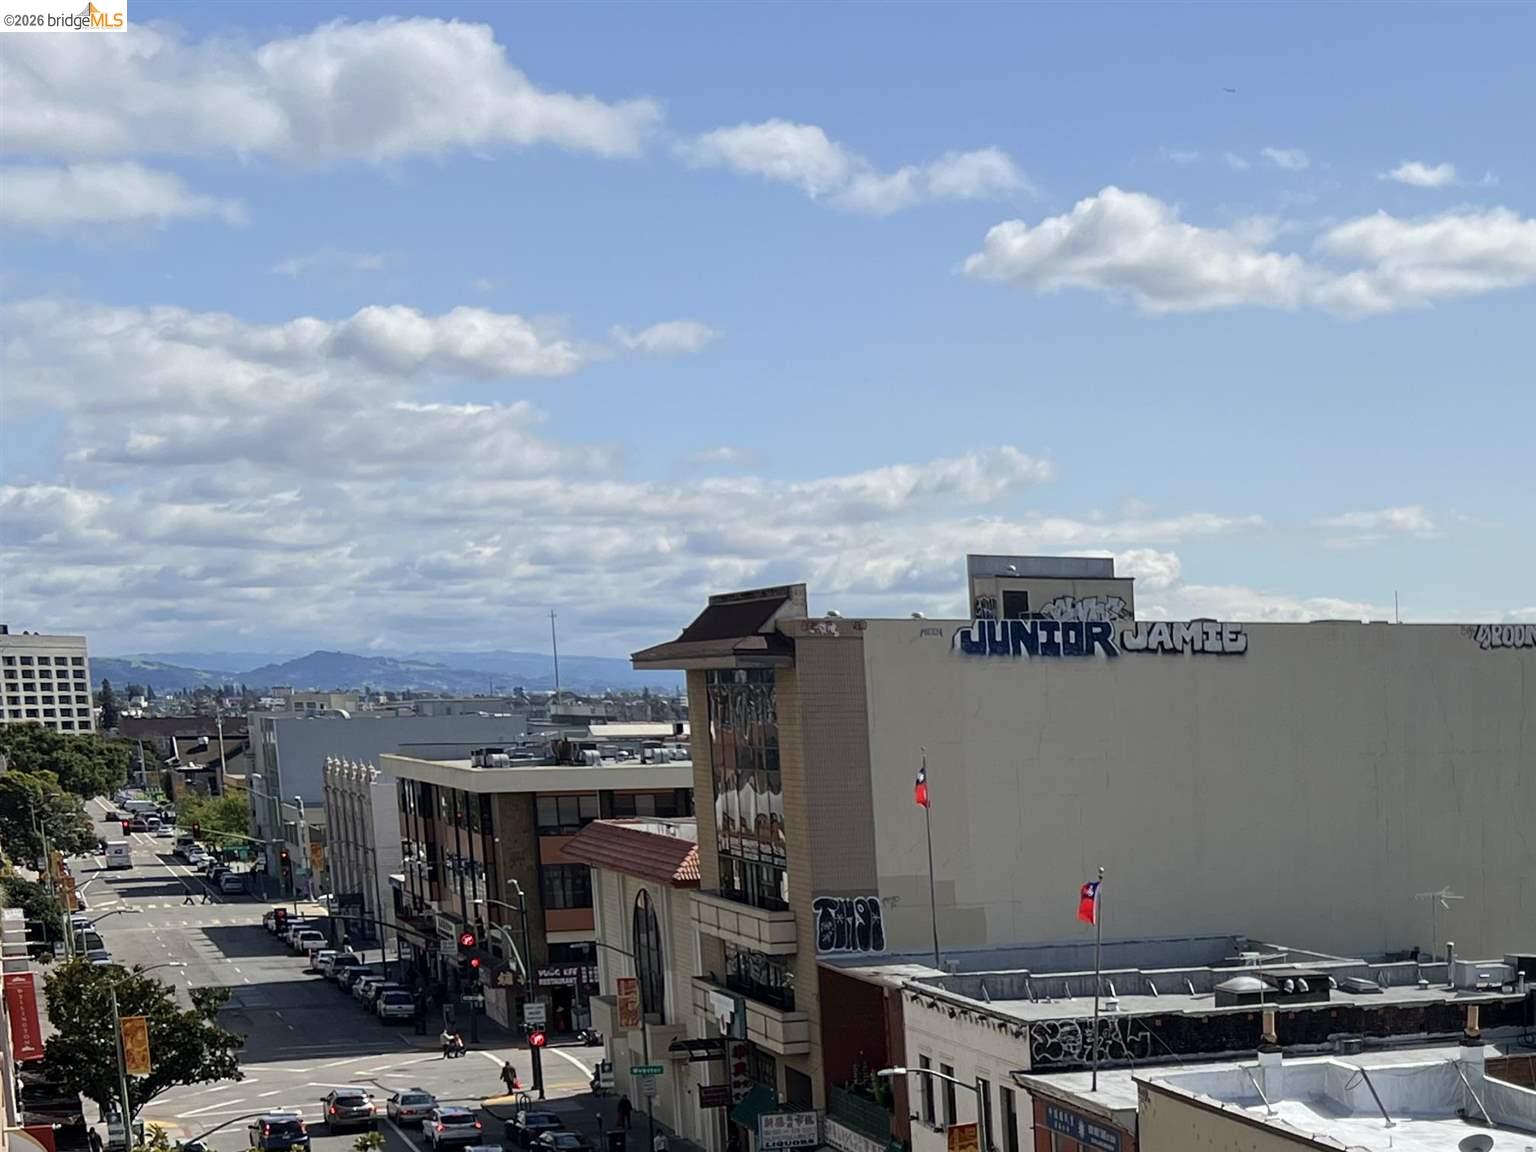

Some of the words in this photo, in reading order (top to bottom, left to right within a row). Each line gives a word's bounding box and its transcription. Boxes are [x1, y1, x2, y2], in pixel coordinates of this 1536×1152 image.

[953, 619, 1120, 657] JUNIOR
[1121, 621, 1248, 655] JAMIE
[765, 1139, 815, 1148] LIQUORS
